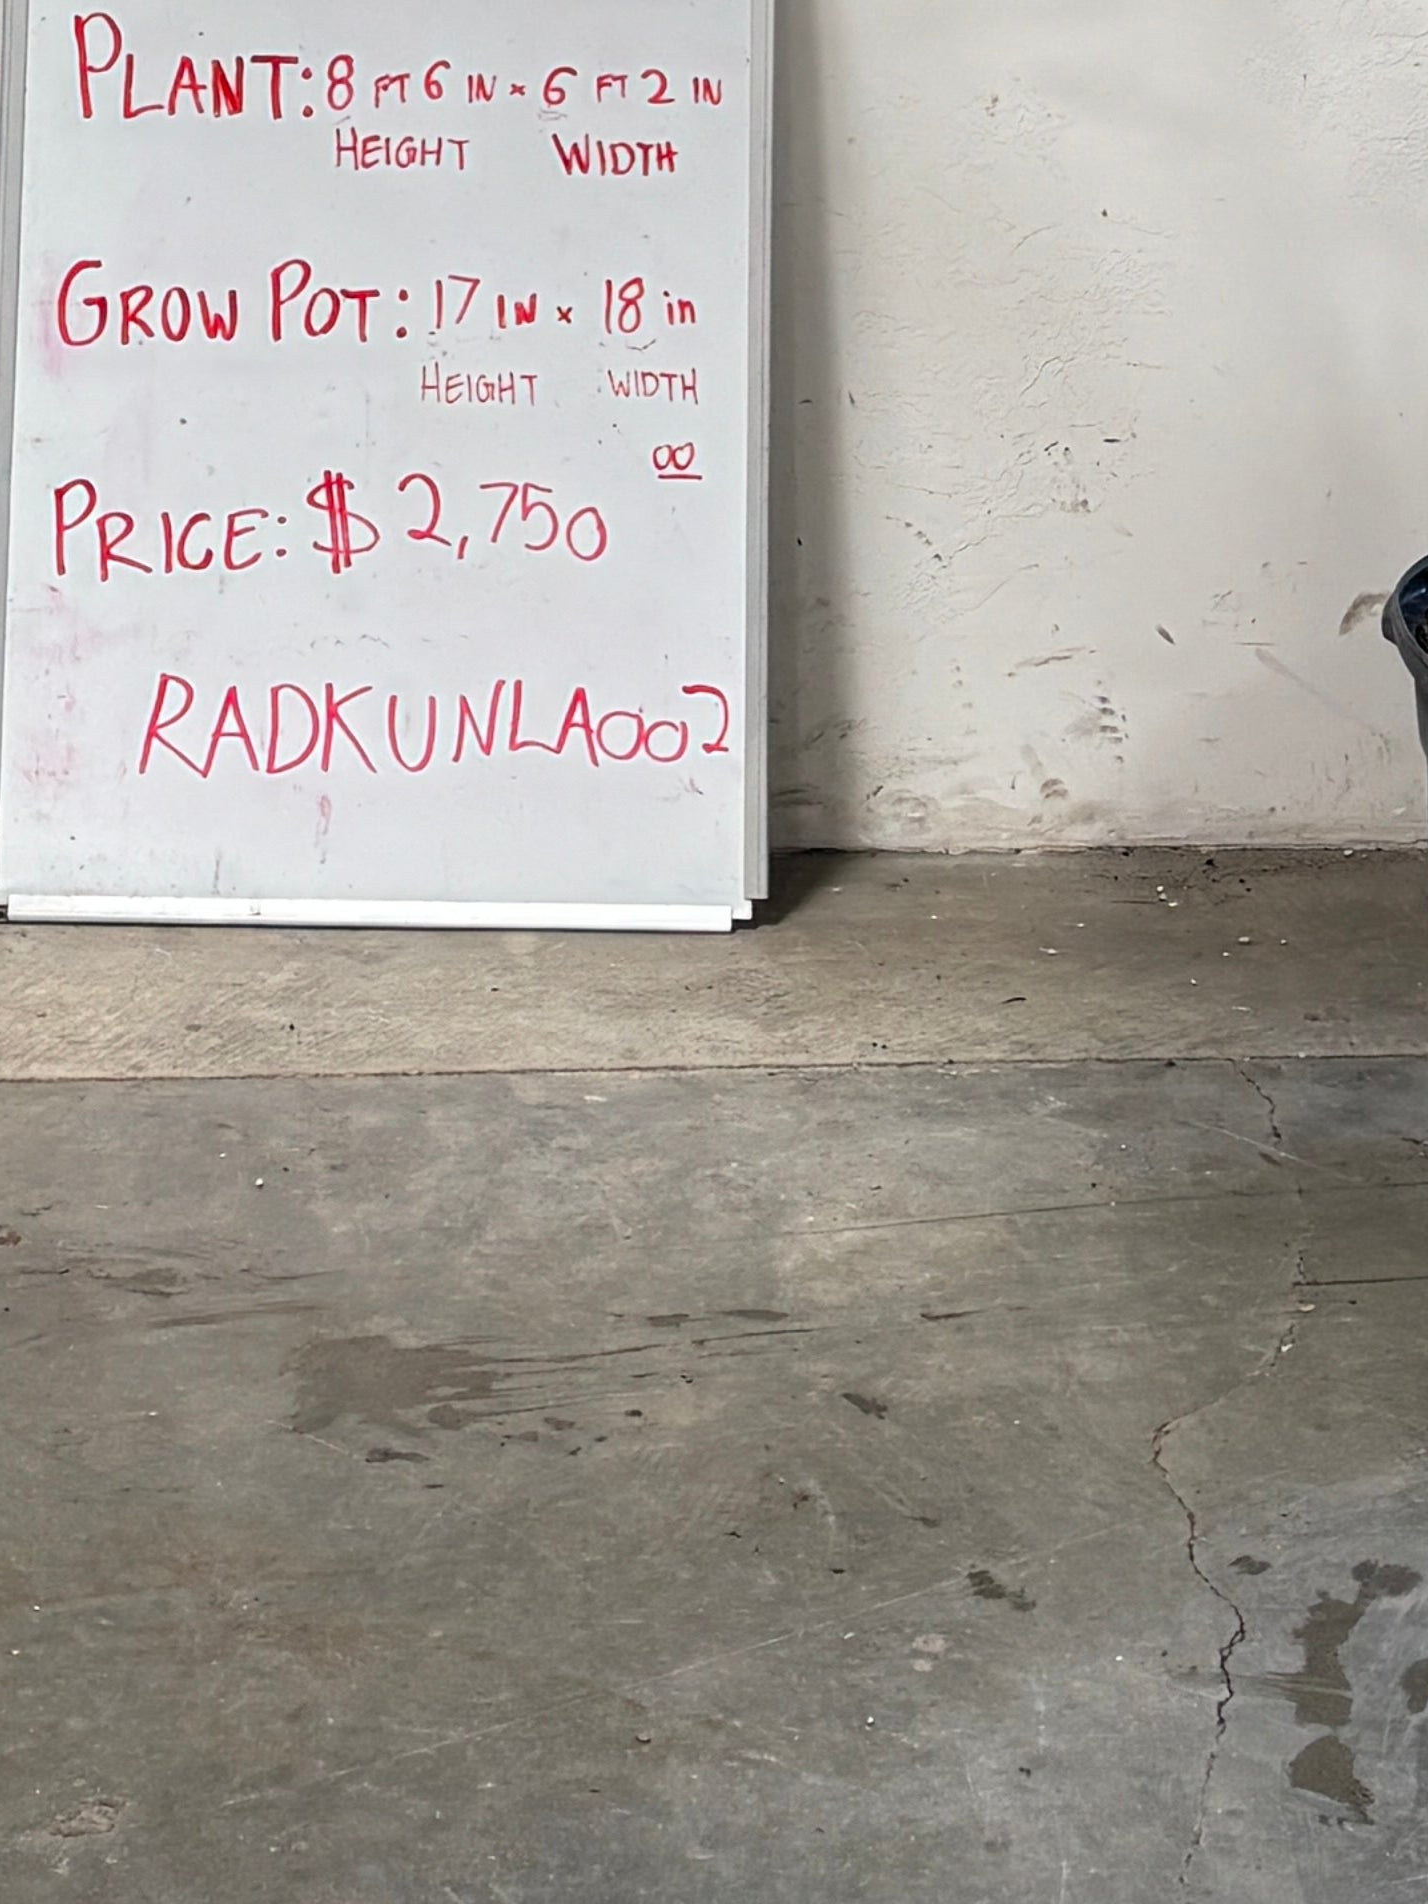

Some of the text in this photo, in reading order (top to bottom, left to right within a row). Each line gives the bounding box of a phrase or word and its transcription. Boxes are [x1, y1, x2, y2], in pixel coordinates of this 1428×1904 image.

[71, 10, 315, 123] PLANT:
[323, 51, 357, 114] 8
[370, 70, 412, 110] FT
[420, 58, 452, 103] 6
[464, 72, 497, 105] IN
[539, 64, 578, 110] 6
[592, 71, 629, 103] FT
[639, 66, 676, 108] 2
[689, 76, 724, 109] IN
[333, 126, 679, 178] HEIGHT WIDTH
[432, 272, 482, 332] 17
[493, 291, 540, 332] IN
[601, 274, 647, 337] 18
[662, 290, 699, 329] in
[417, 362, 701, 407] HEIGHT WIDTH
[51, 477, 288, 585] PRICE:
